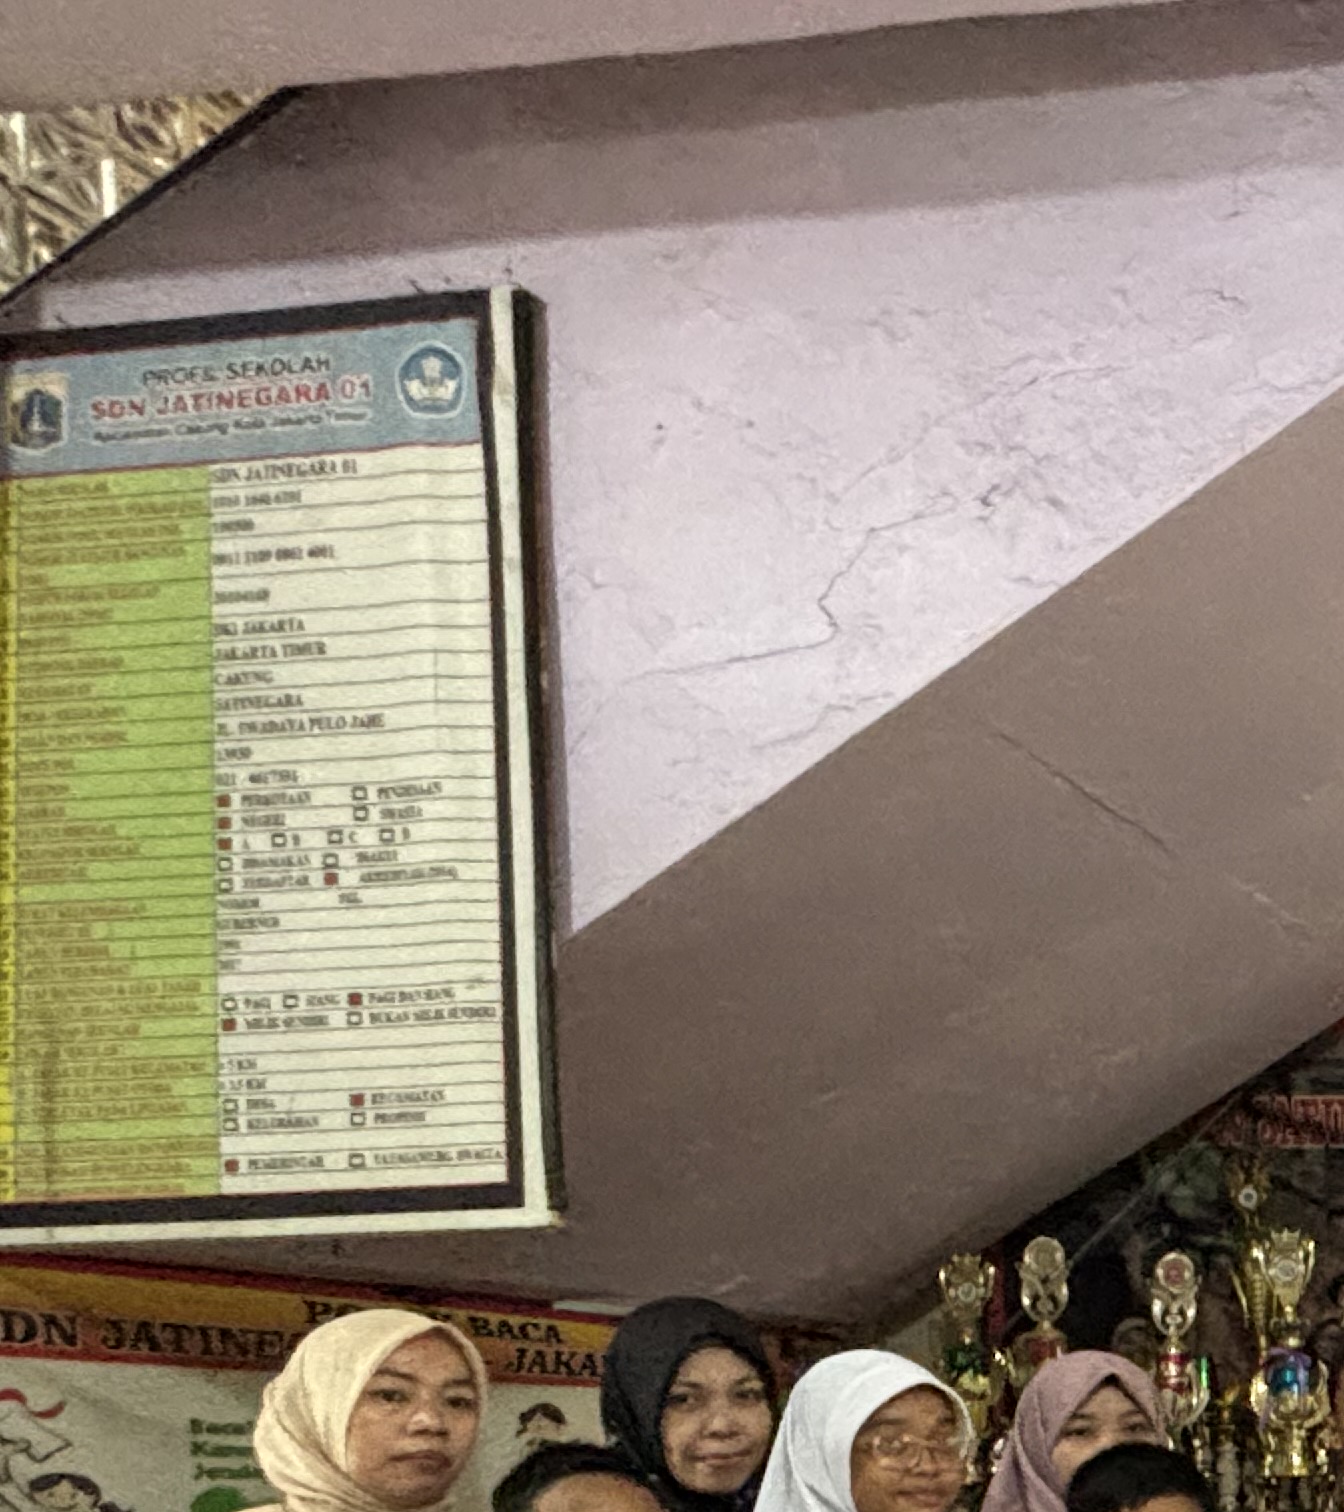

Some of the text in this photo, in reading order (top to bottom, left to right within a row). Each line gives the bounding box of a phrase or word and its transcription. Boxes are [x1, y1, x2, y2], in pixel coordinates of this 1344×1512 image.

[226, 357, 331, 380] SEKOLAH
[91, 376, 371, 419] SDN JATINEGARA 01
[0, 1308, 78, 1348] DN
[101, 1317, 306, 1358] JATINE
[503, 1345, 606, 1379] JAKA
[468, 1315, 562, 1345] BACA
